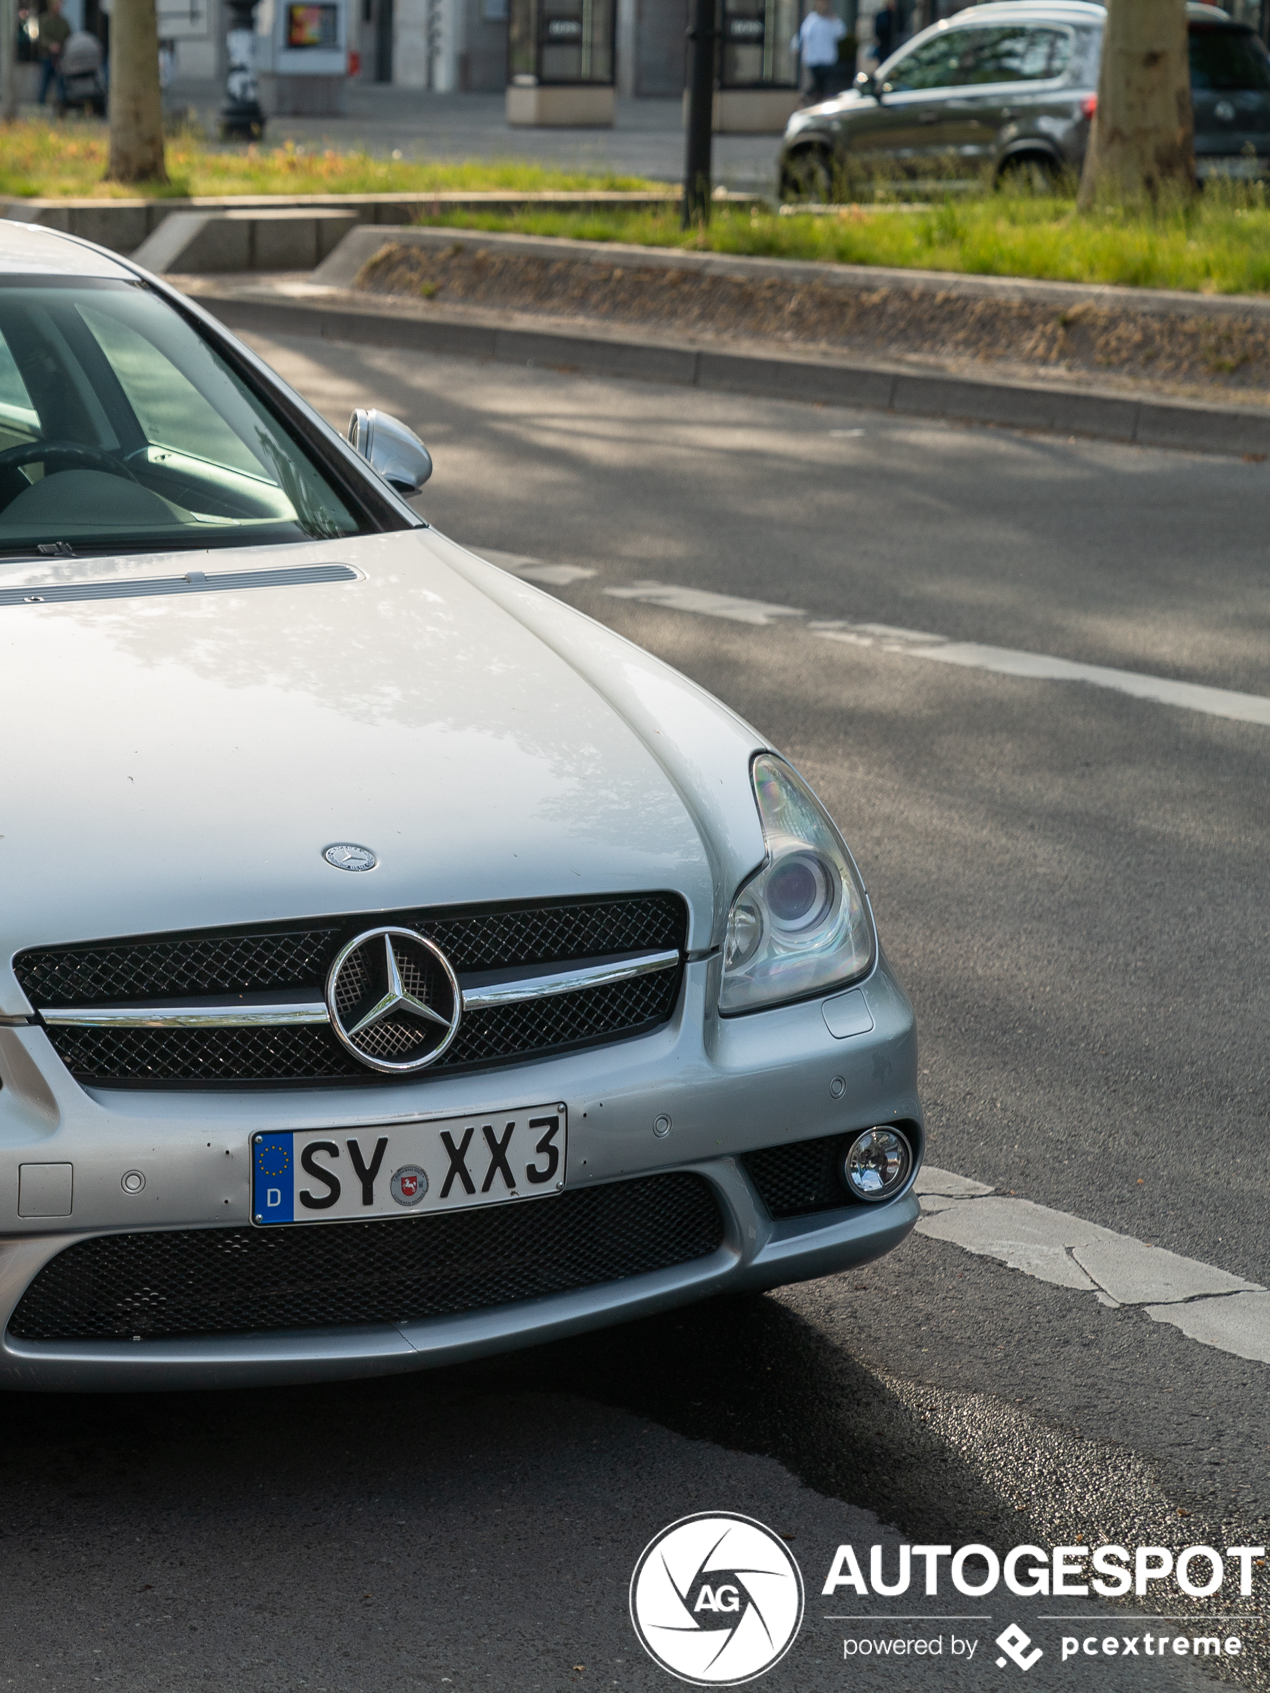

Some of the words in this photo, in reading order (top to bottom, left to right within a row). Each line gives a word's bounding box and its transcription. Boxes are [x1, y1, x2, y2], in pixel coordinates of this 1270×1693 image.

[299, 1136, 389, 1210] SY
[439, 1115, 560, 1199] XX3
[266, 1188, 282, 1208] D
